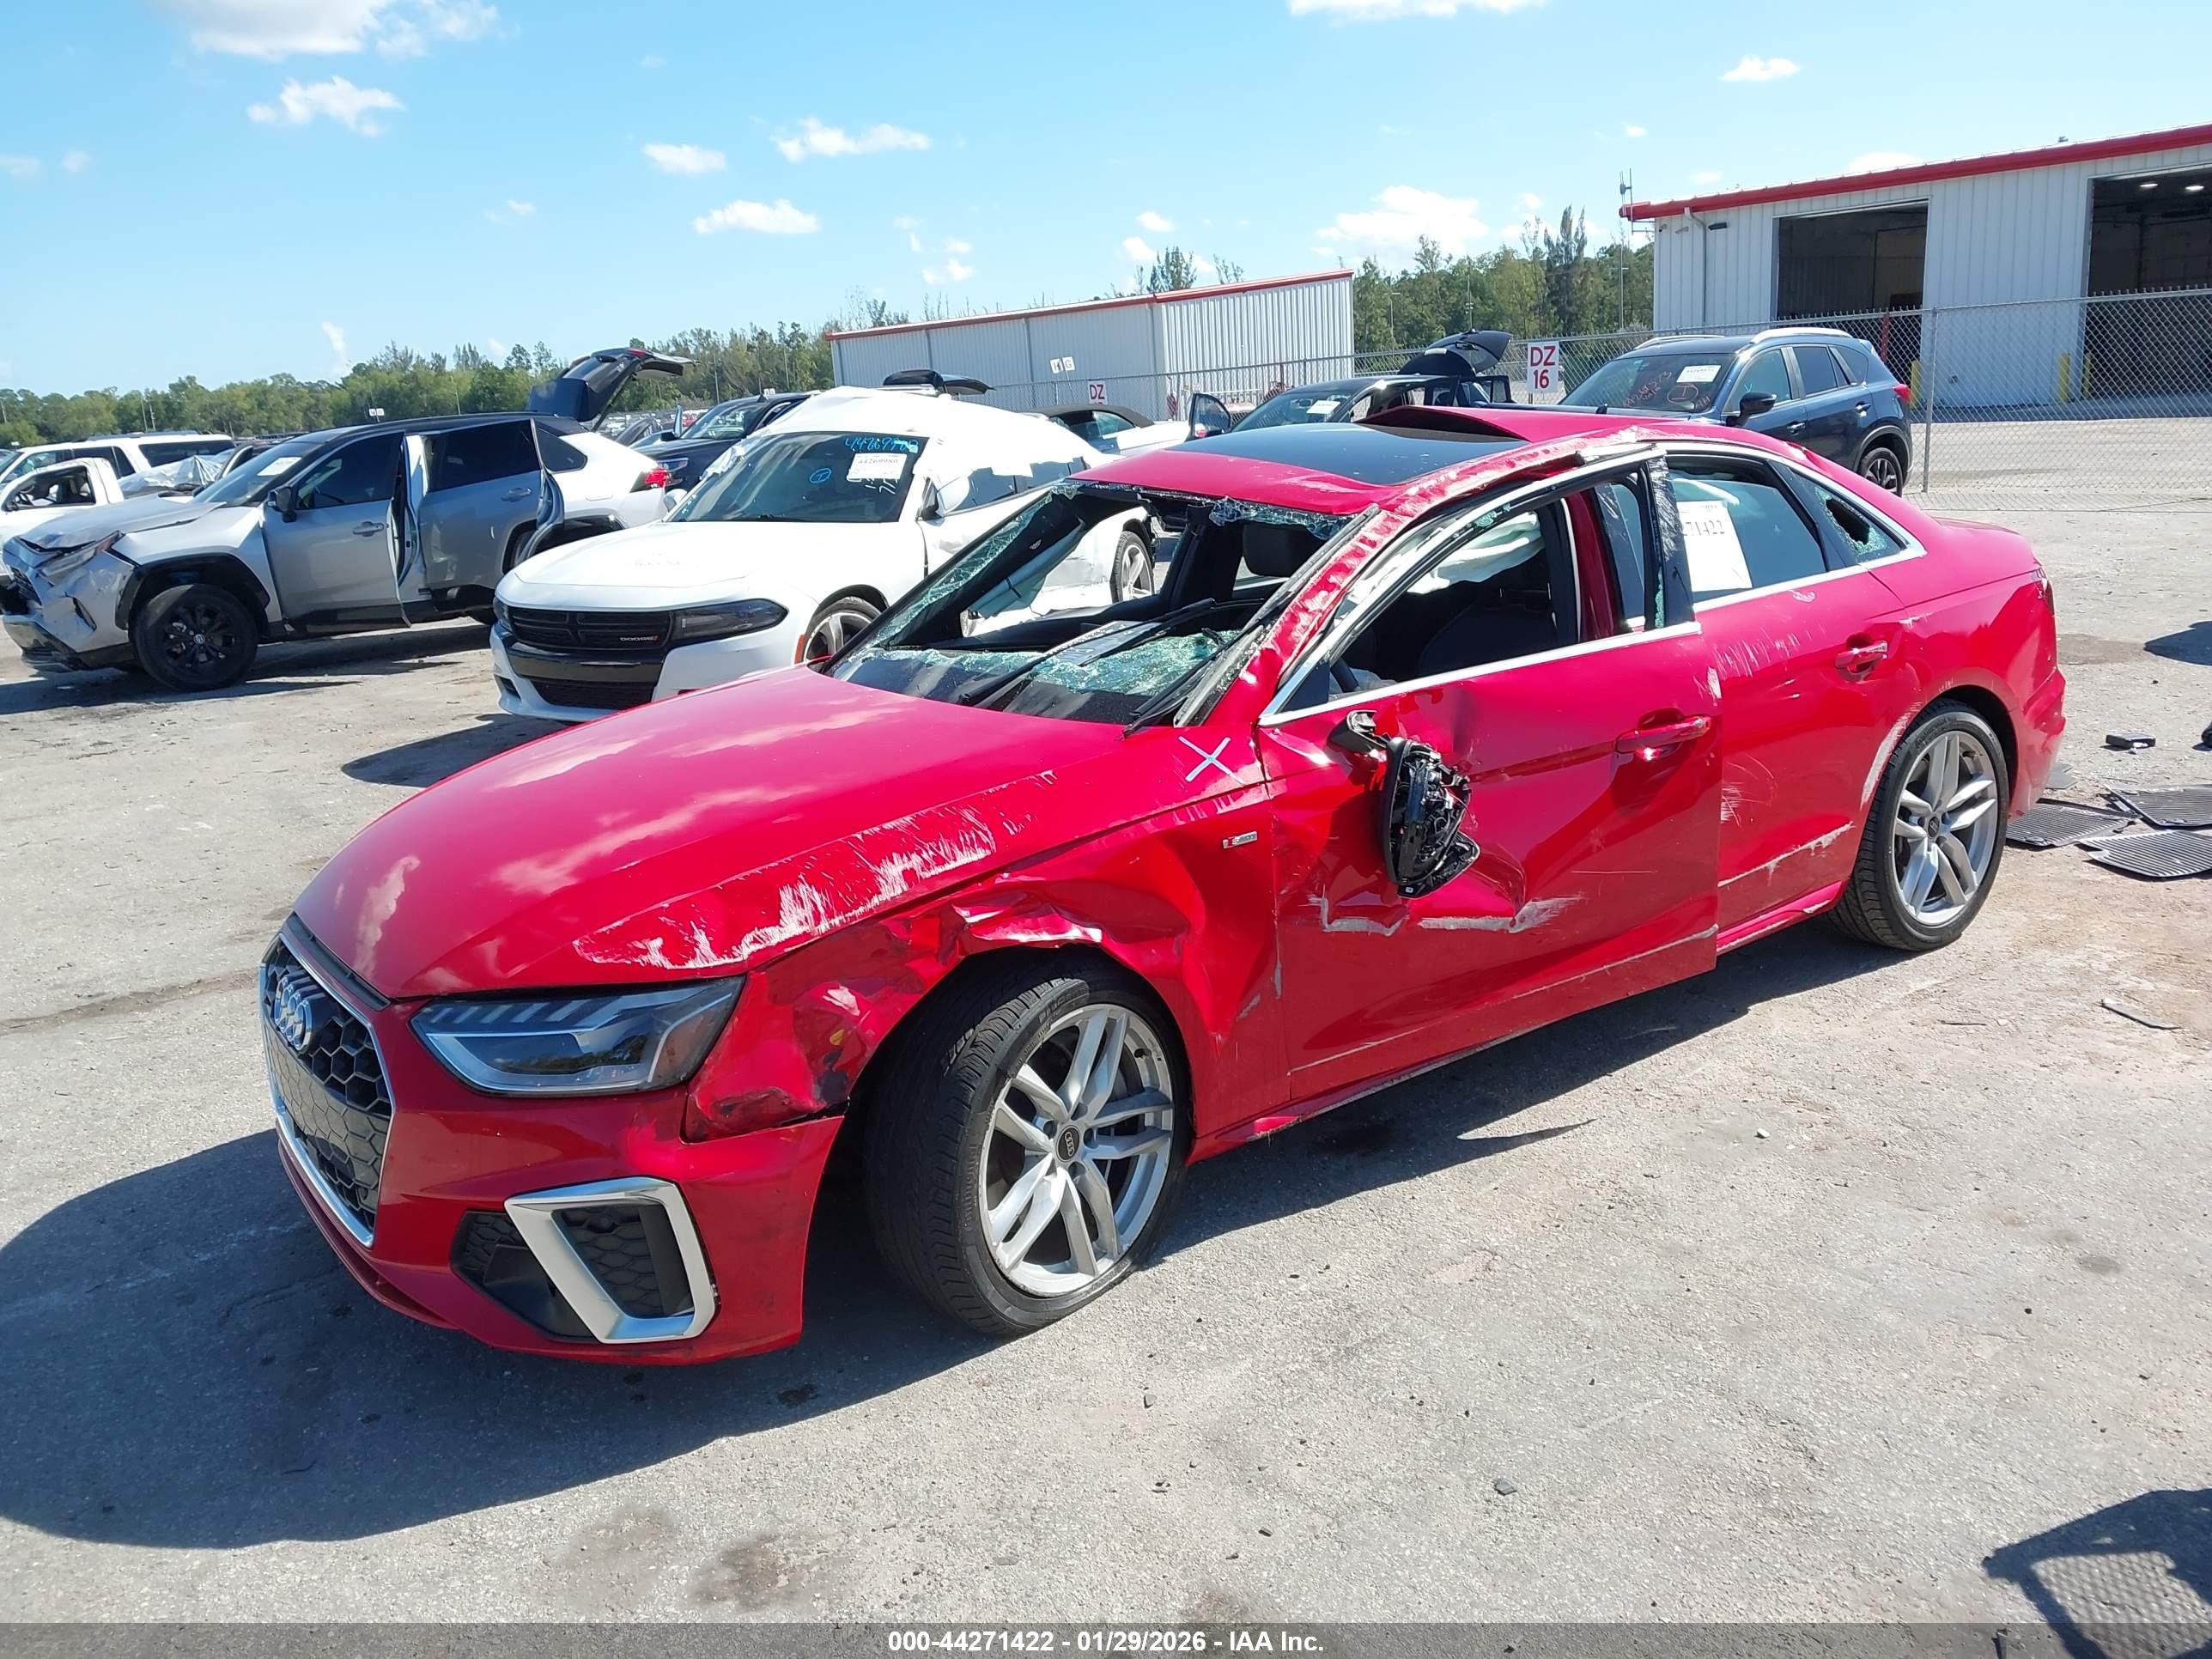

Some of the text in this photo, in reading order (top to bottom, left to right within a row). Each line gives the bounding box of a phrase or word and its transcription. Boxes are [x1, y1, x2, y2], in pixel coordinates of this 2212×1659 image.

[1530, 345, 1556, 367] DZ
[1533, 369, 1550, 389] 16
[1089, 384, 1105, 400] DZ
[1682, 520, 1725, 536] 71422
